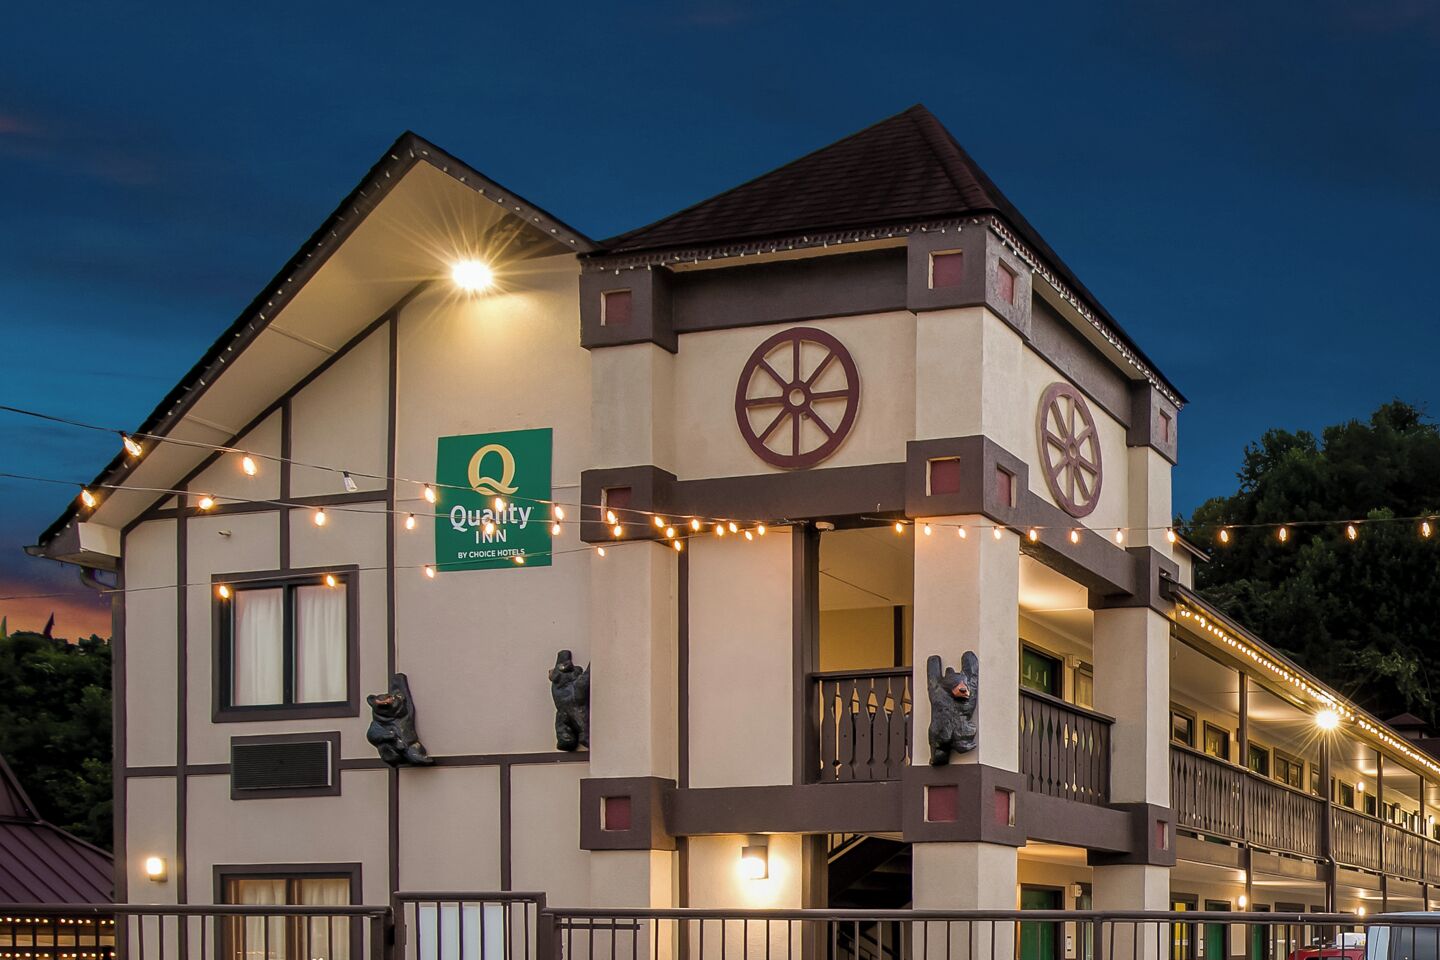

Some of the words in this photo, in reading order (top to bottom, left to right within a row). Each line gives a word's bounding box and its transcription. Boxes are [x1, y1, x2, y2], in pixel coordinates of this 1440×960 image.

[468, 444, 519, 496] Q
[475, 529, 507, 544] INN
[469, 550, 496, 558] CHOICE
[497, 548, 526, 557] HOTELS
